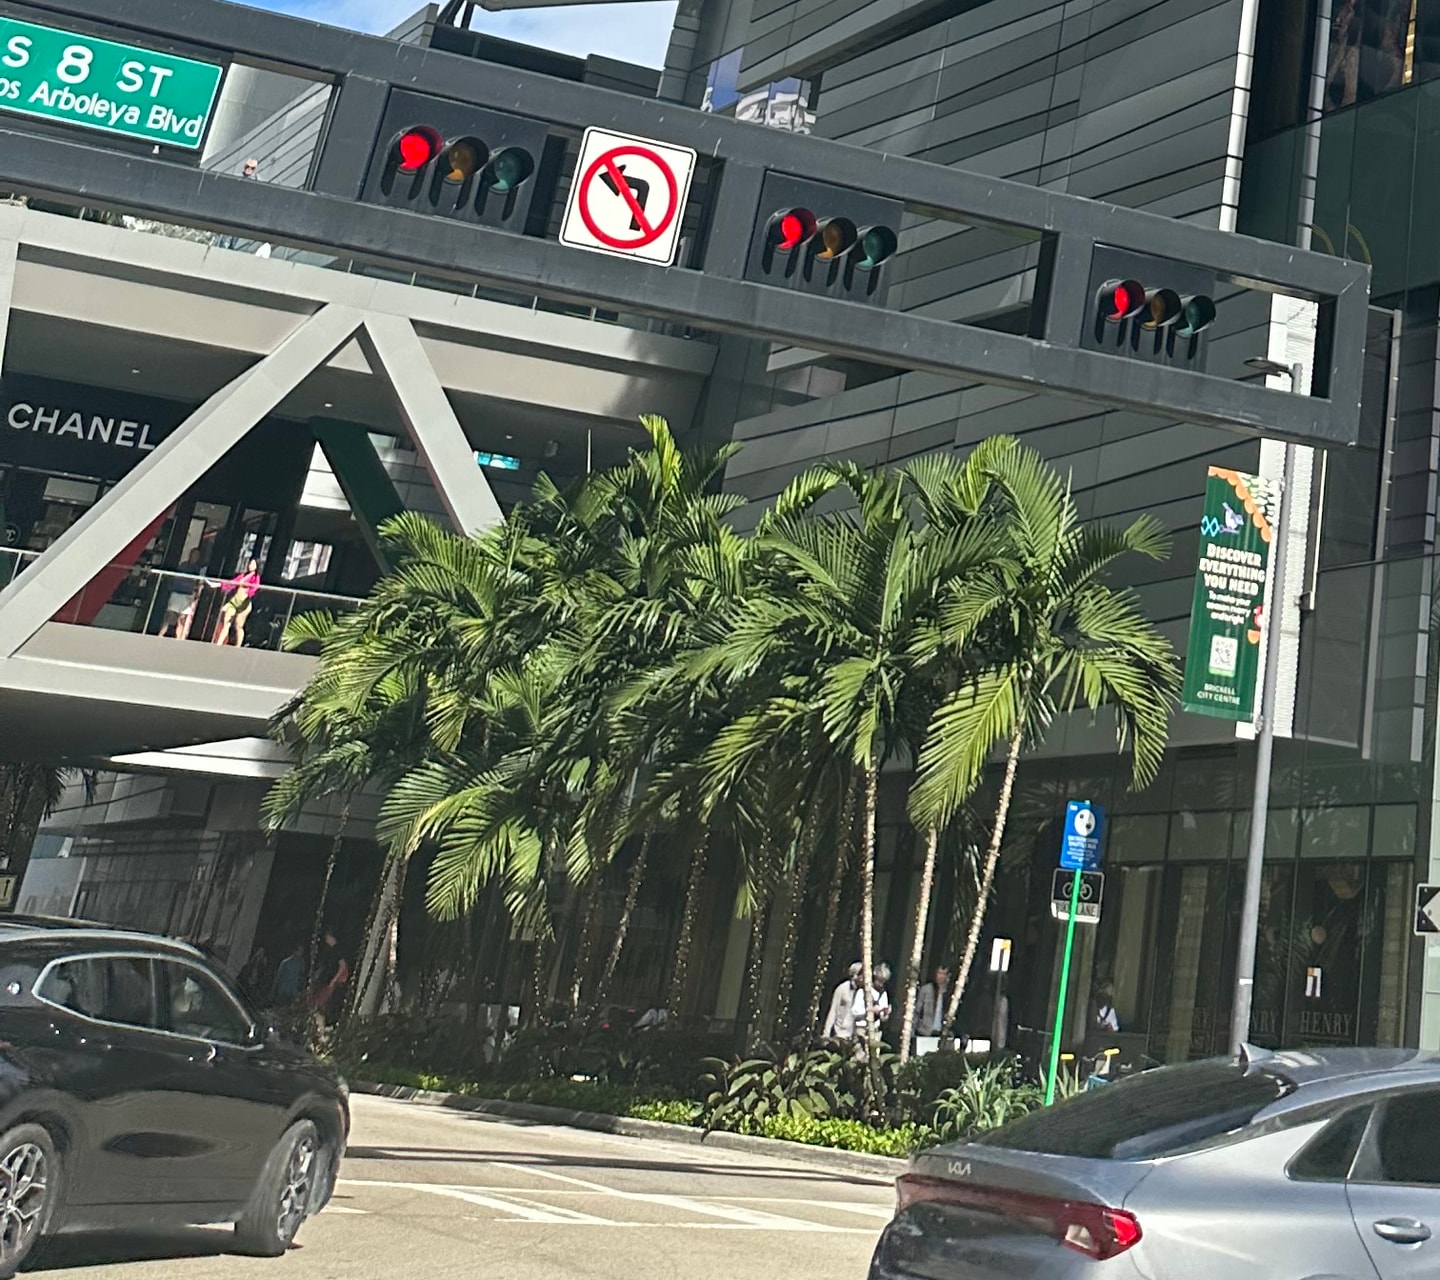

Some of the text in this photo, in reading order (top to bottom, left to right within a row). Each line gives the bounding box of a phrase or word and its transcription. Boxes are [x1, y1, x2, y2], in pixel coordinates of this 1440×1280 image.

[56, 44, 94, 84] 8
[116, 60, 173, 97] ST
[28, 80, 141, 127] Arboleya
[146, 104, 203, 138] Blvd
[7, 402, 156, 451] CHANEL
[1206, 543, 1262, 567] DISCOVER
[1199, 557, 1266, 583] EVERYTHING
[1204, 573, 1259, 596] YOU NEED
[1196, 690, 1213, 700] CITY
[1300, 1011, 1352, 1037] HENRY
